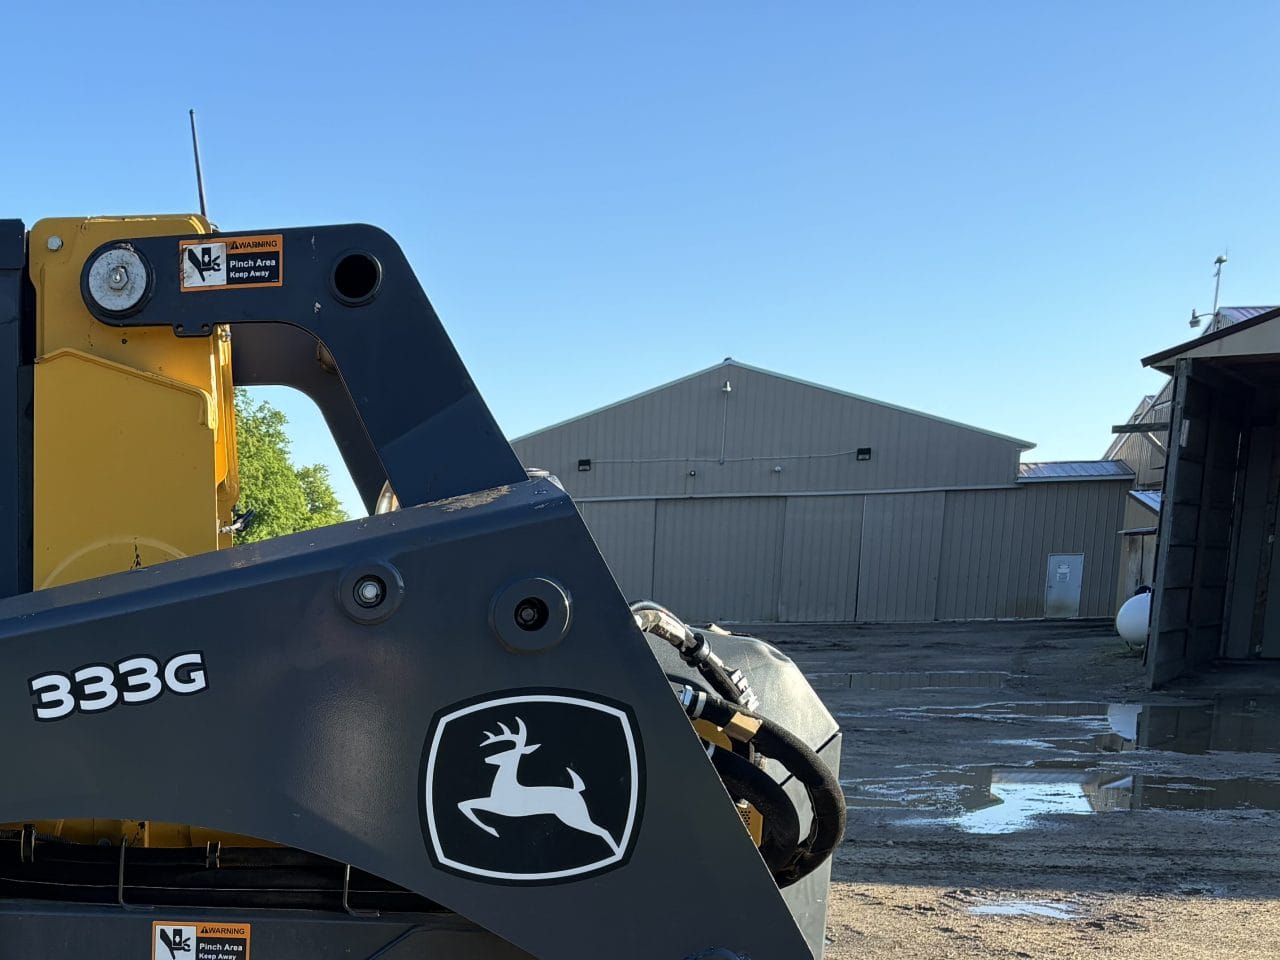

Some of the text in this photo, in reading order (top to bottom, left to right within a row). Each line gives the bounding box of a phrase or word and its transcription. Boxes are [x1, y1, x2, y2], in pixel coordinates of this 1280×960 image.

[239, 240, 278, 249] WARNING
[230, 259, 276, 268] Pinch Area
[230, 270, 270, 279] Keep Away
[31, 653, 206, 719] 333G
[208, 927, 245, 935] WARNING
